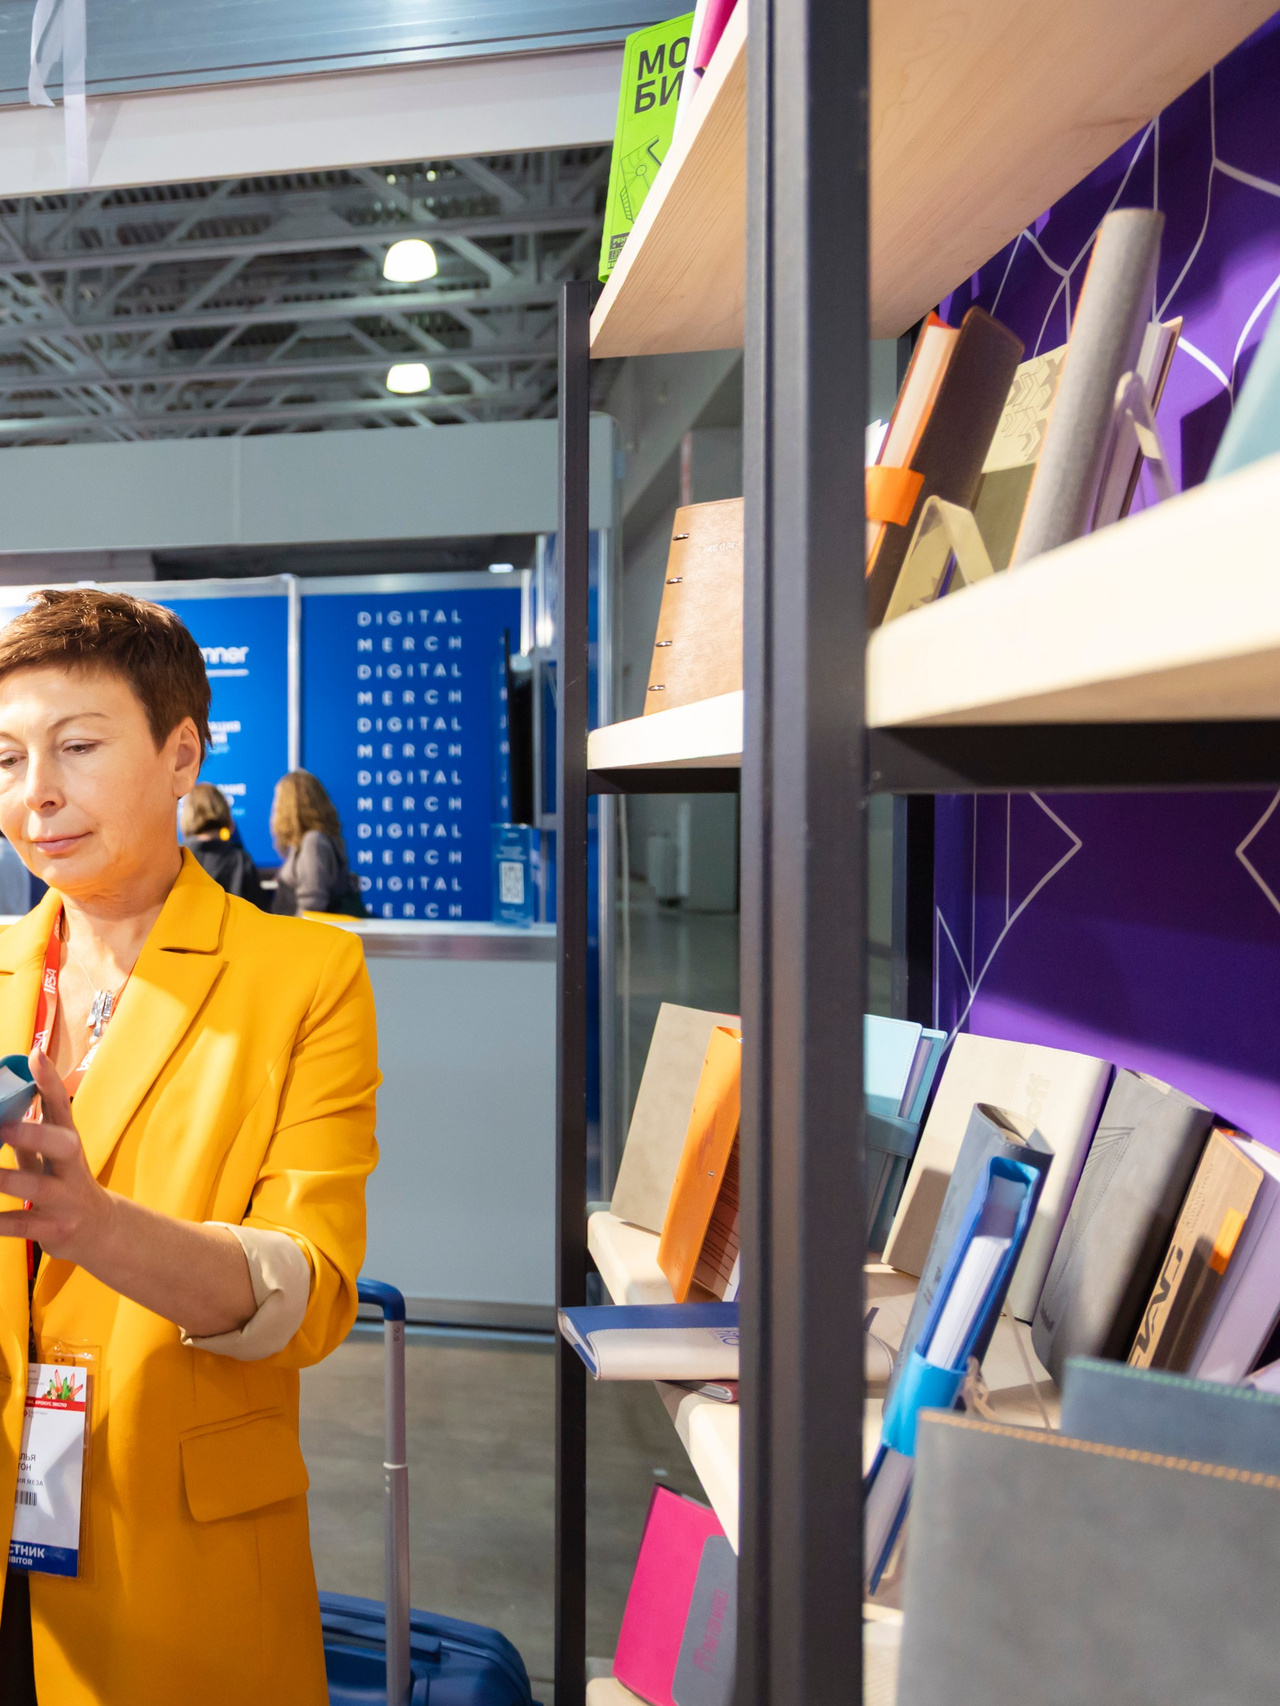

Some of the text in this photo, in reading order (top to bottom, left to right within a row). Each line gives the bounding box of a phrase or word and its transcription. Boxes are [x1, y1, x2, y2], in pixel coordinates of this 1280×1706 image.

[357, 609, 462, 626] DIGITAL
[357, 636, 462, 652] MERCH
[357, 663, 462, 680] DIGITAL
[357, 690, 462, 706] MERCH
[357, 716, 462, 733] DIGITAL
[357, 743, 462, 759] MERCH
[357, 769, 462, 787] DIGITAL
[357, 796, 462, 812] MERCH
[357, 822, 462, 840] DIGITAL
[357, 849, 462, 865] MERCH
[359, 875, 462, 892] DIGITAL
[365, 903, 462, 918] ERCH
